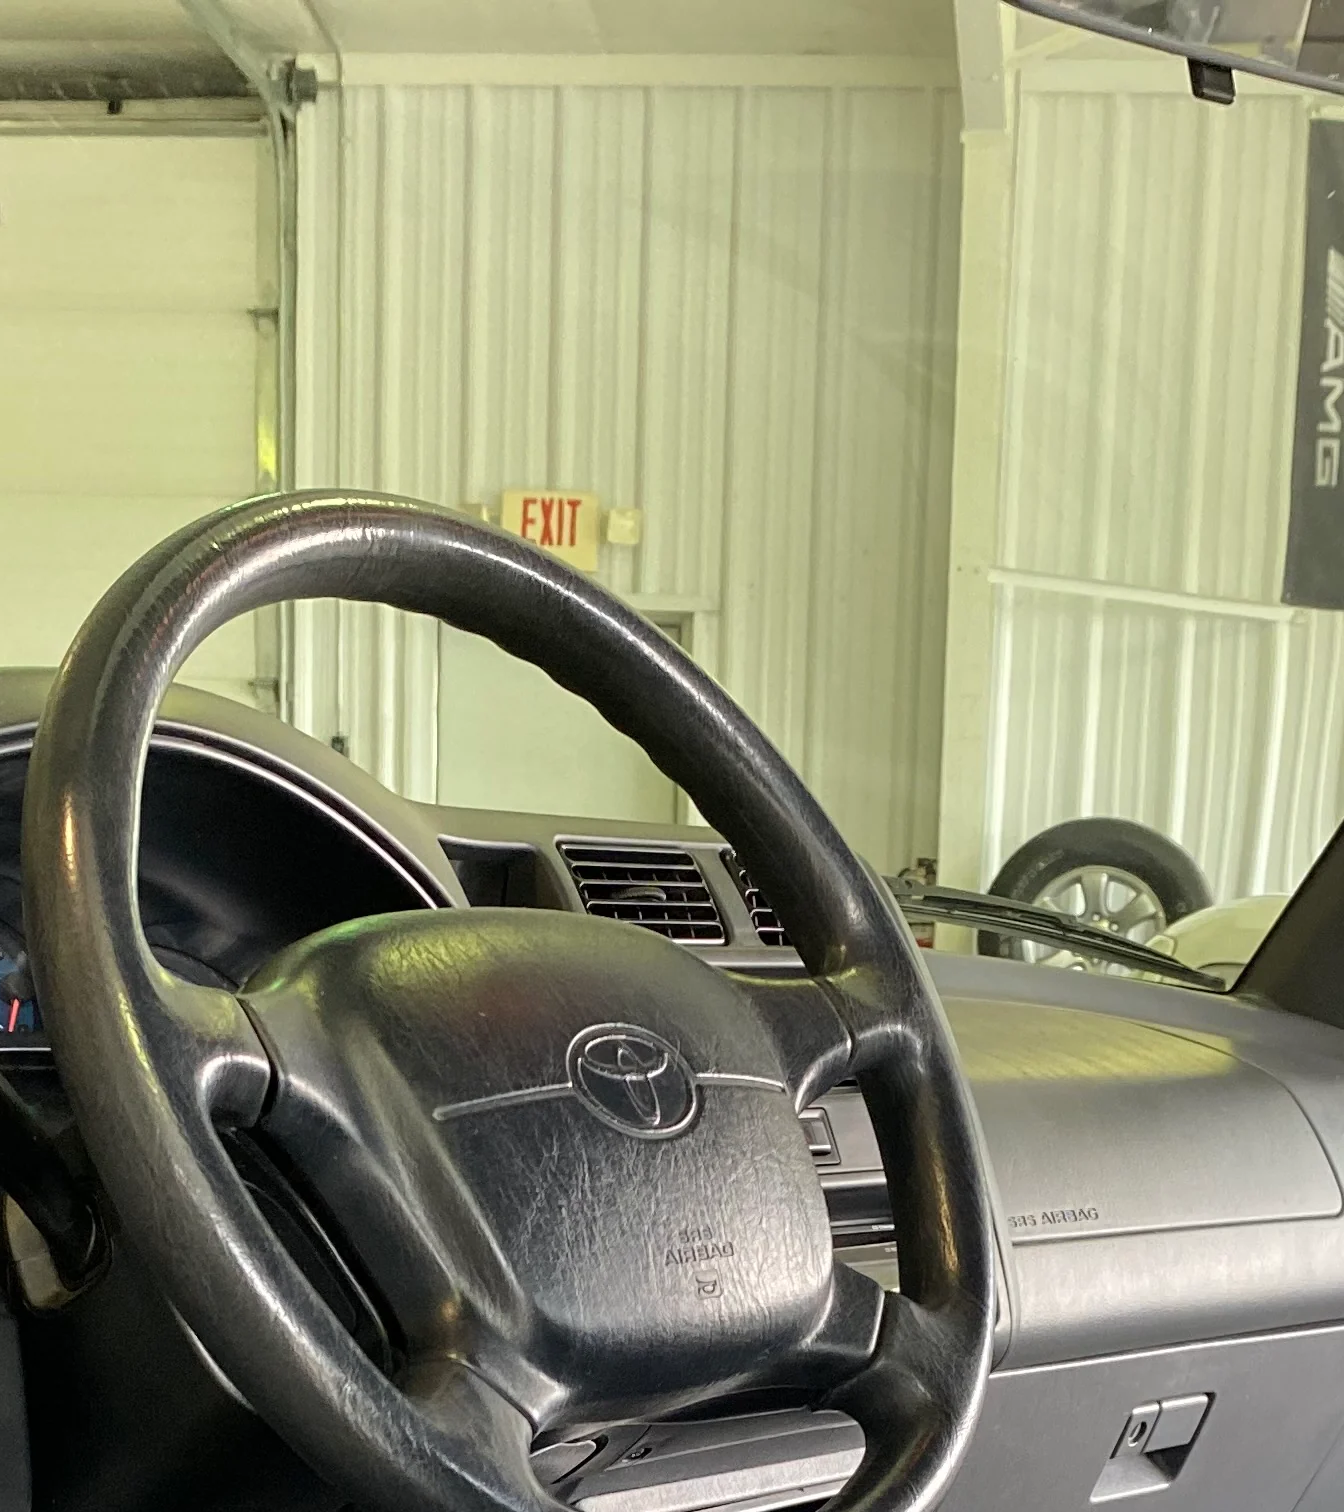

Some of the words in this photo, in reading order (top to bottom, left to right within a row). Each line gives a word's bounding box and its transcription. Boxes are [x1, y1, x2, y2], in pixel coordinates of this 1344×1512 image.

[1314, 317, 1344, 487] AMG
[520, 497, 582, 547] EXIT
[1041, 1207, 1099, 1225] AIRBAG
[664, 1241, 735, 1267] AIRBAG
